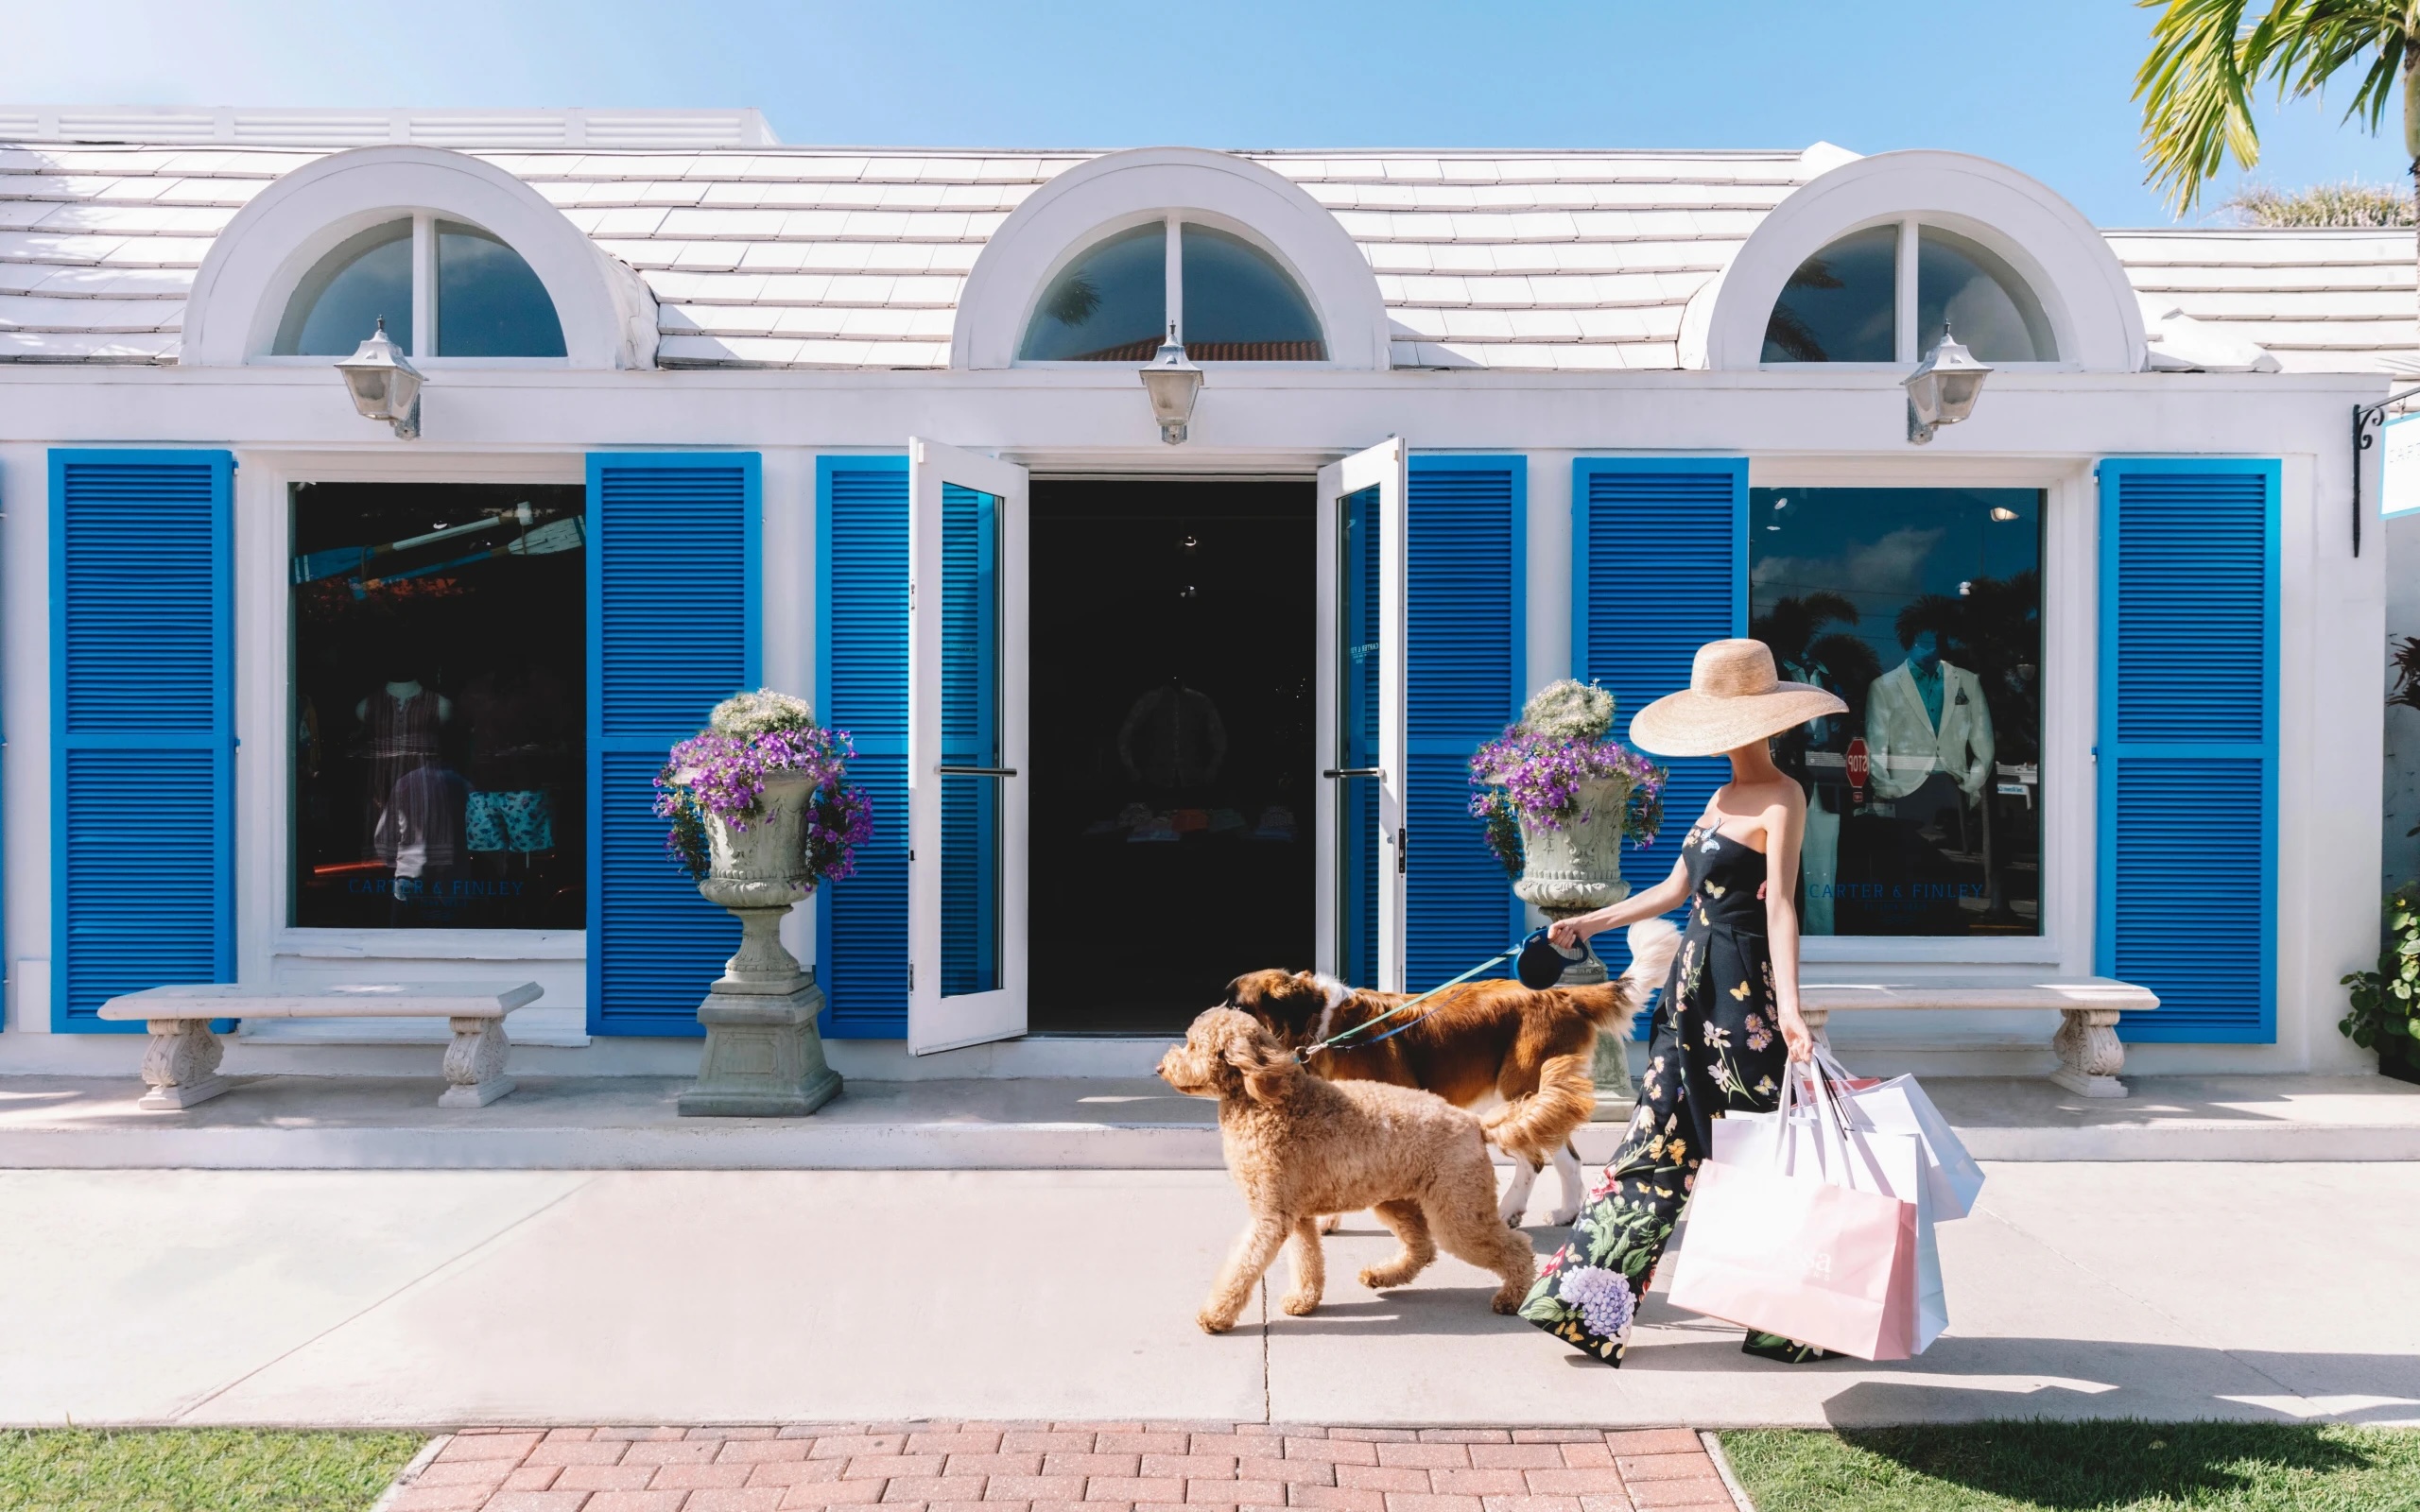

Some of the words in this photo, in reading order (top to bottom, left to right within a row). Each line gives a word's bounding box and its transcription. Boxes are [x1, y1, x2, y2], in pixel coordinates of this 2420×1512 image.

[349, 879, 424, 893] CARTER
[433, 881, 442, 895] &
[453, 881, 524, 895] FINLEY
[1809, 884, 1884, 899] CARTER
[1893, 885, 1902, 899] &
[1912, 884, 1984, 899] FINLEY
